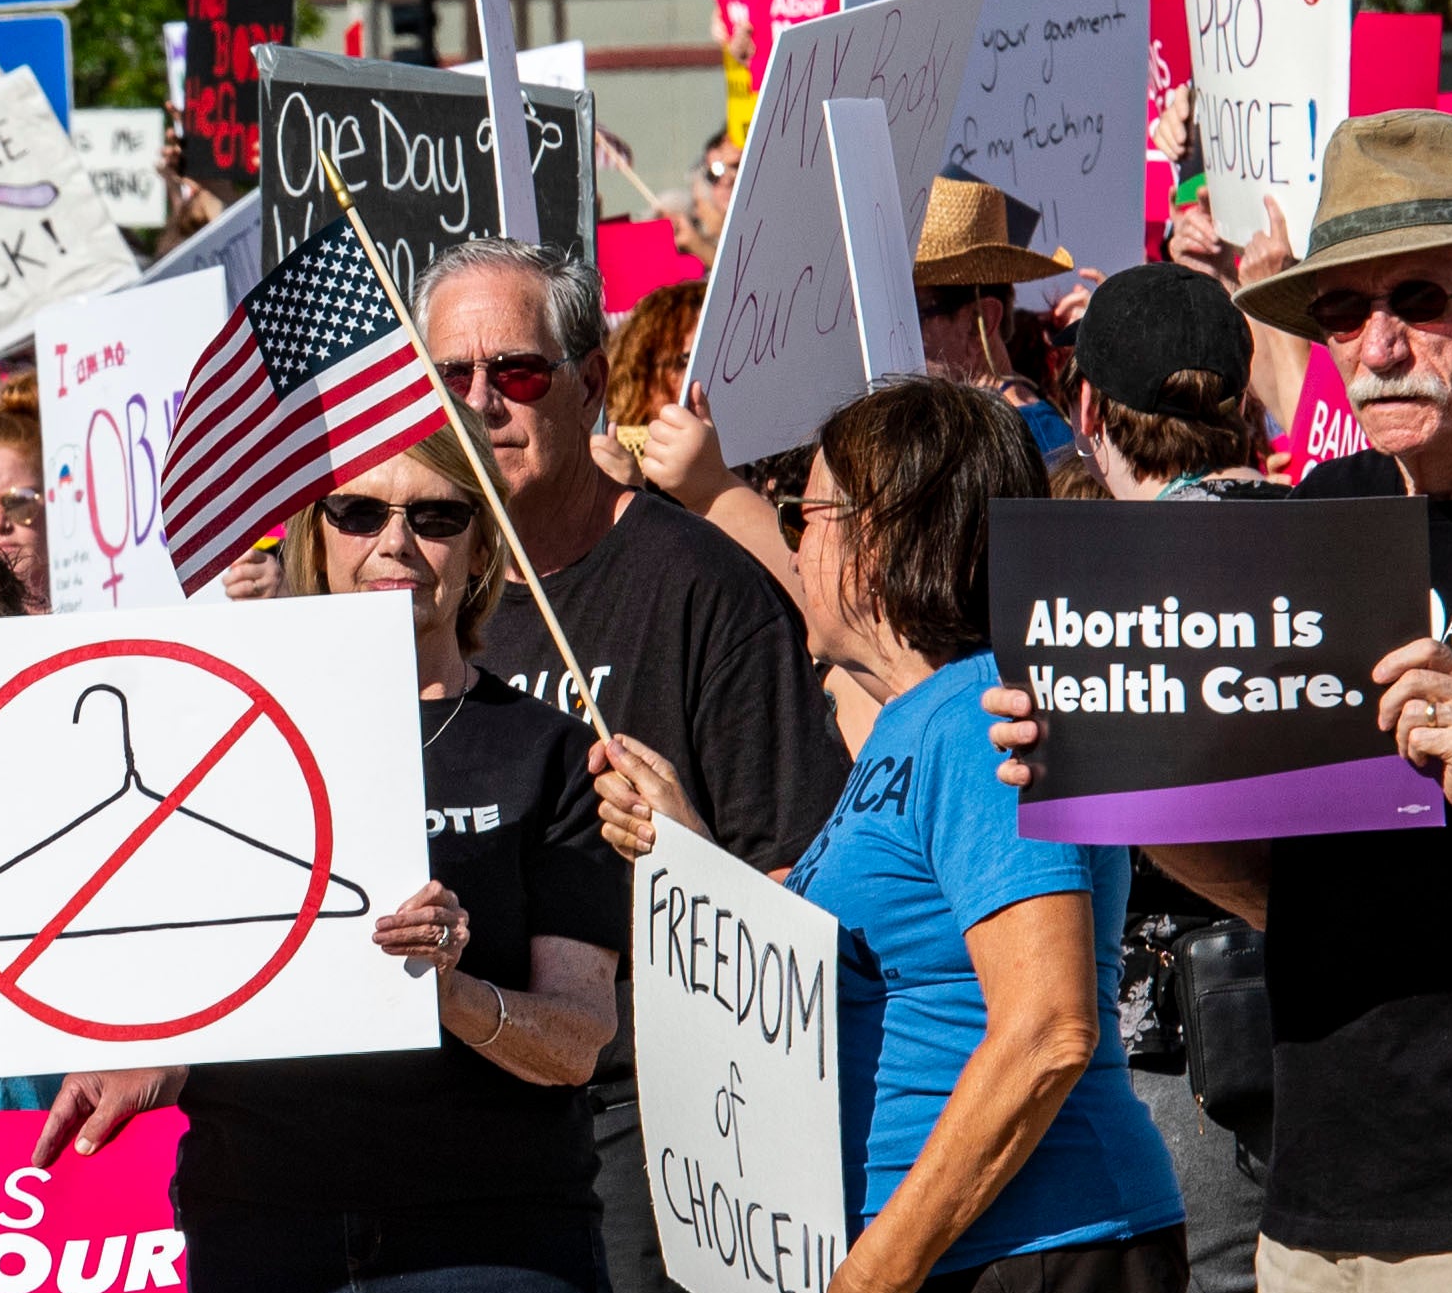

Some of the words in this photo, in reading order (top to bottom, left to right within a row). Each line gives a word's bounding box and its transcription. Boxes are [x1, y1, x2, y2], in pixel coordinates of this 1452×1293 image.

[981, 22, 1031, 93] your
[277, 92, 367, 197] One
[371, 97, 470, 234] Day
[987, 137, 1019, 186] my
[1021, 92, 1105, 175] fucking
[55, 344, 68, 398] I
[1025, 596, 1257, 648] Abortion
[1273, 595, 1324, 648] is
[1029, 663, 1186, 715] Health
[1201, 665, 1364, 715] Care.
[426, 803, 501, 838] OTE
[649, 868, 825, 1080] FREEDOM
[715, 1061, 746, 1178] of
